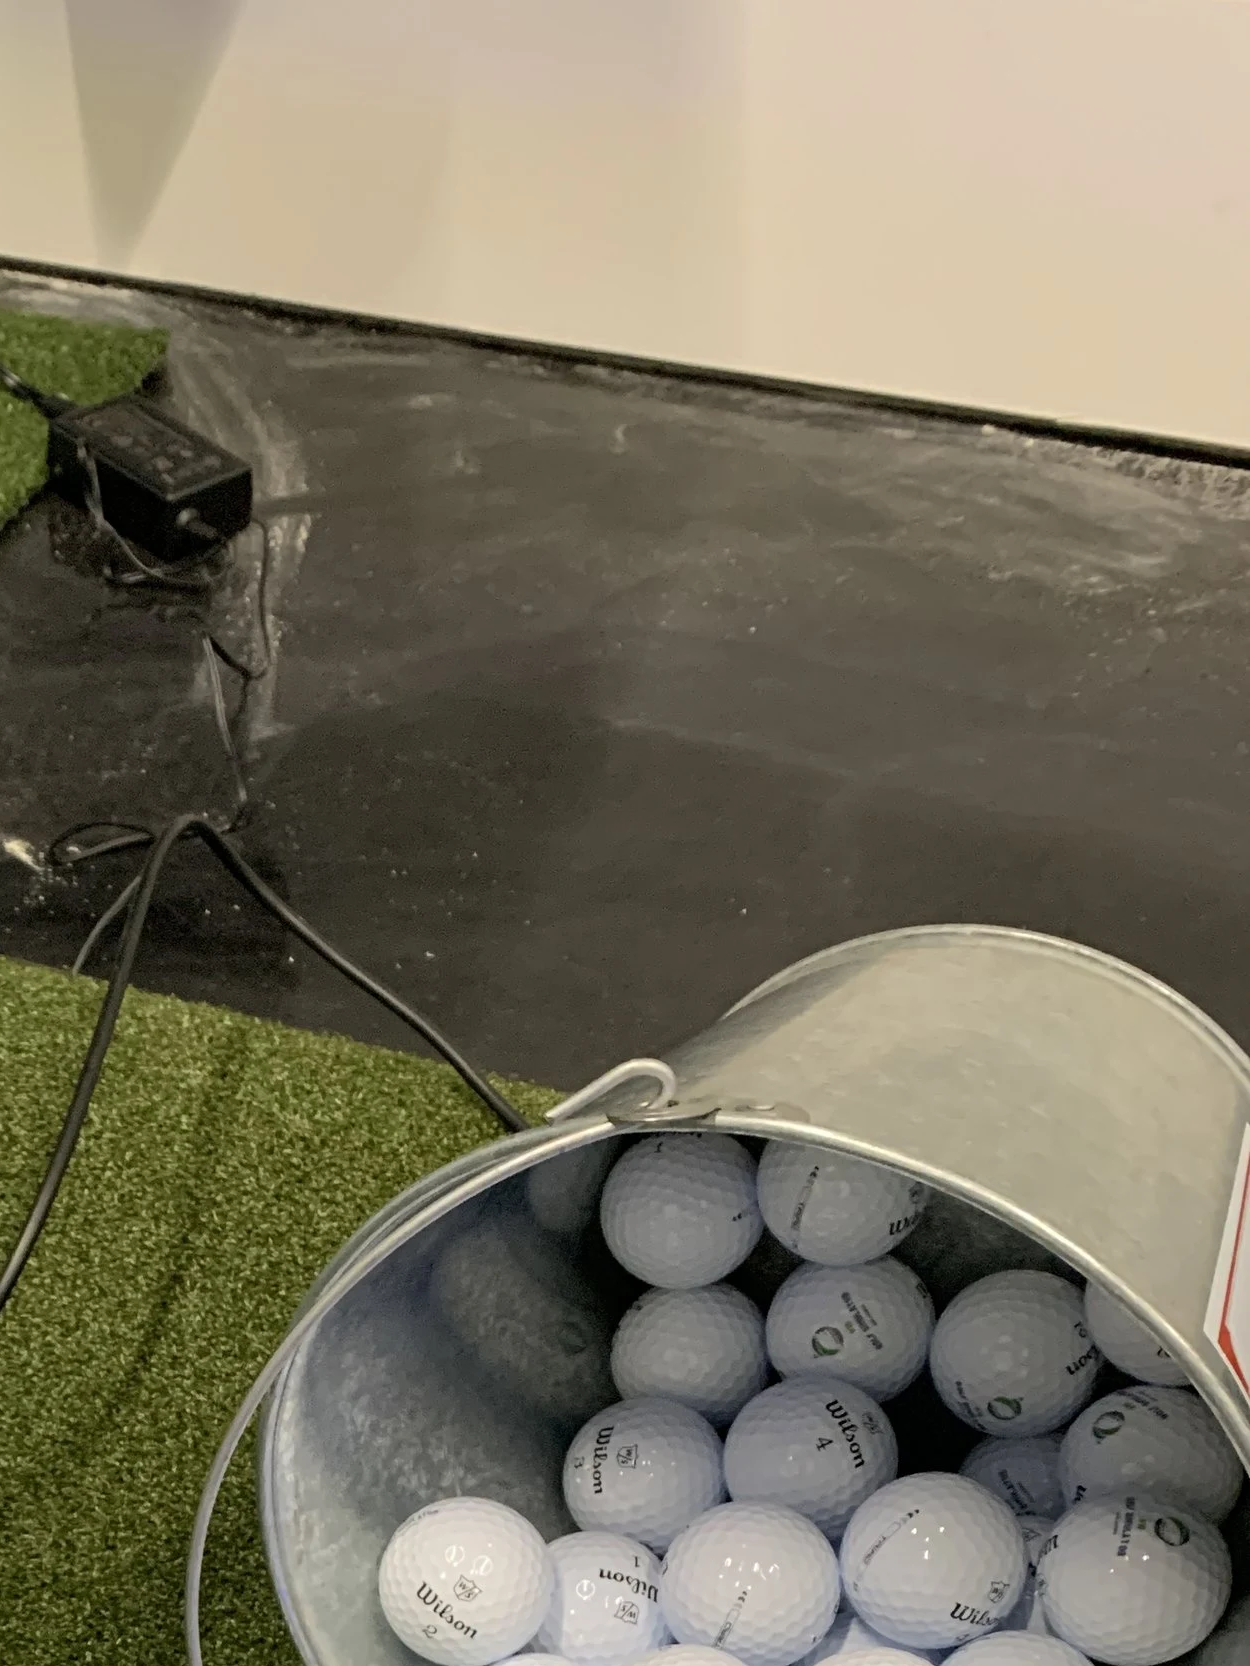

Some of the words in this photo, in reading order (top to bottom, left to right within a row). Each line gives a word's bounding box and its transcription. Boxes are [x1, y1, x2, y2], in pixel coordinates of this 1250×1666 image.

[815, 1436, 833, 1451] 4
[824, 1399, 865, 1469] Wilson
[592, 1426, 615, 1494] Wilson
[633, 1555, 641, 1568] 1
[599, 1568, 659, 1603] Wilson
[415, 1581, 478, 1640] Wilson
[422, 1623, 438, 1639] 2
